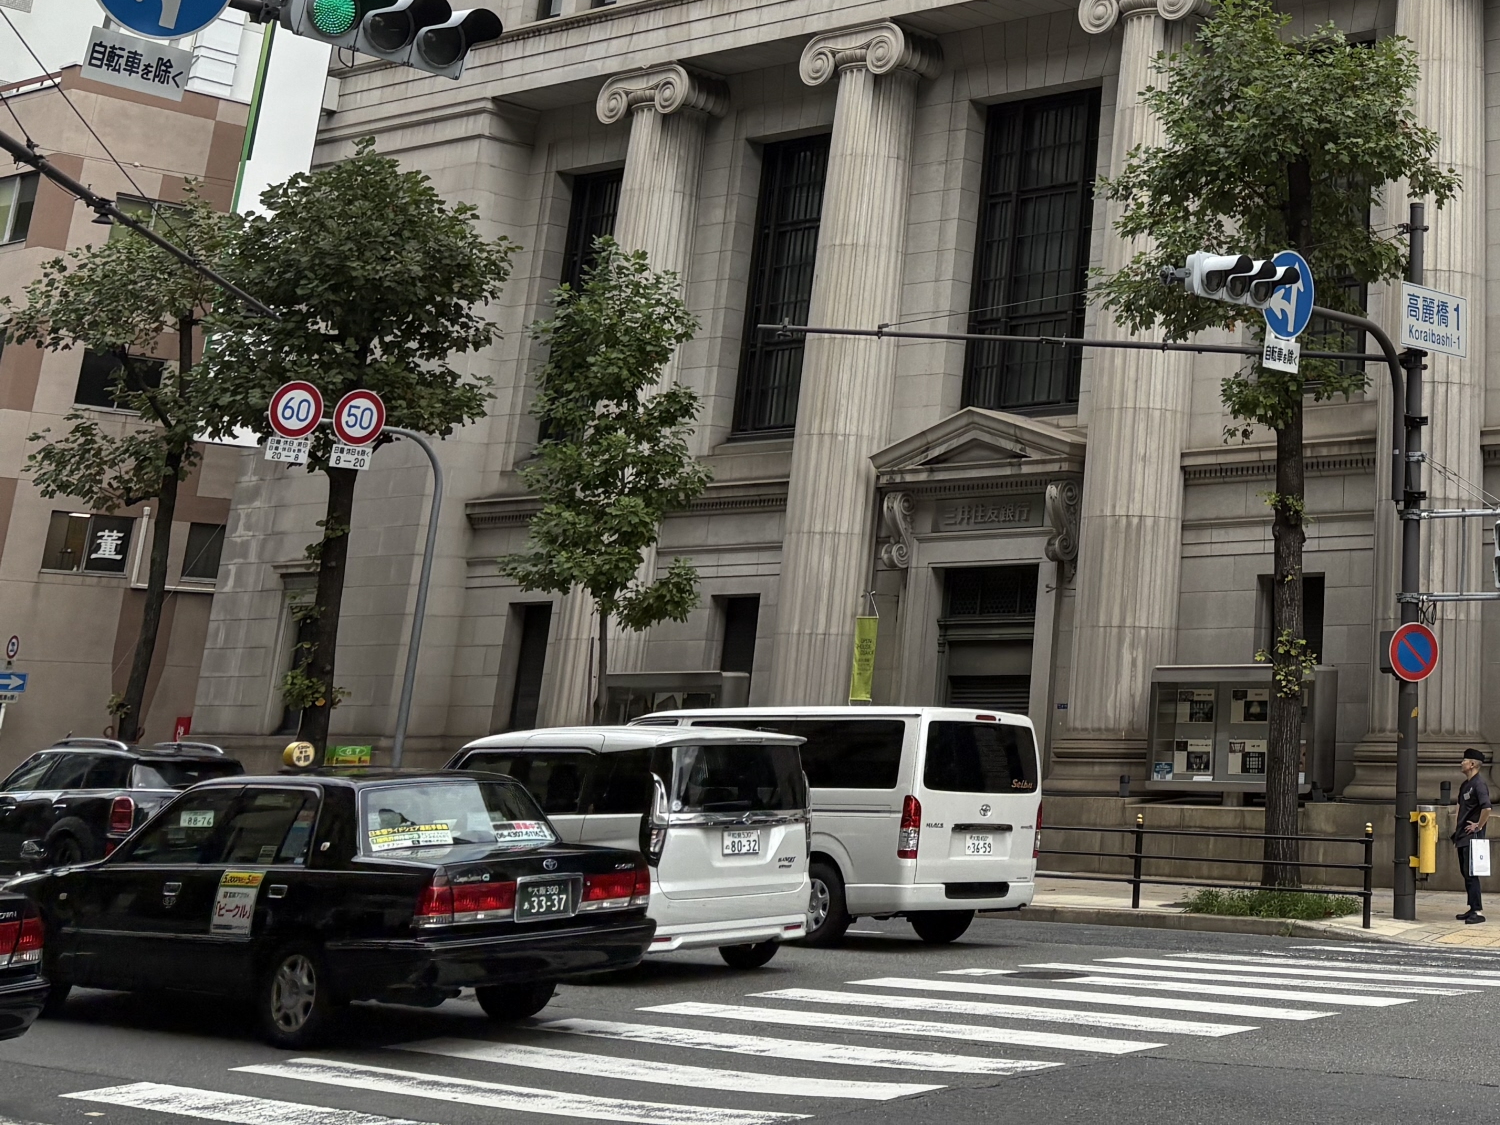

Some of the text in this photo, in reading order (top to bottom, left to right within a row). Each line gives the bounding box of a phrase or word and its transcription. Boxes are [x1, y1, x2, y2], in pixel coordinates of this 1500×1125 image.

[88, 41, 183, 88] 自転車を除く
[1408, 324, 1461, 350] Koraibashi-1
[1265, 345, 1298, 366] 自転車を除く
[281, 397, 312, 423] 60
[345, 404, 374, 430] 50
[943, 502, 1031, 526] 三井住友銀行
[187, 816, 212, 826] 88-76
[730, 839, 758, 853] 80-32
[971, 842, 992, 854] 36-59
[531, 894, 567, 913] 33-37
